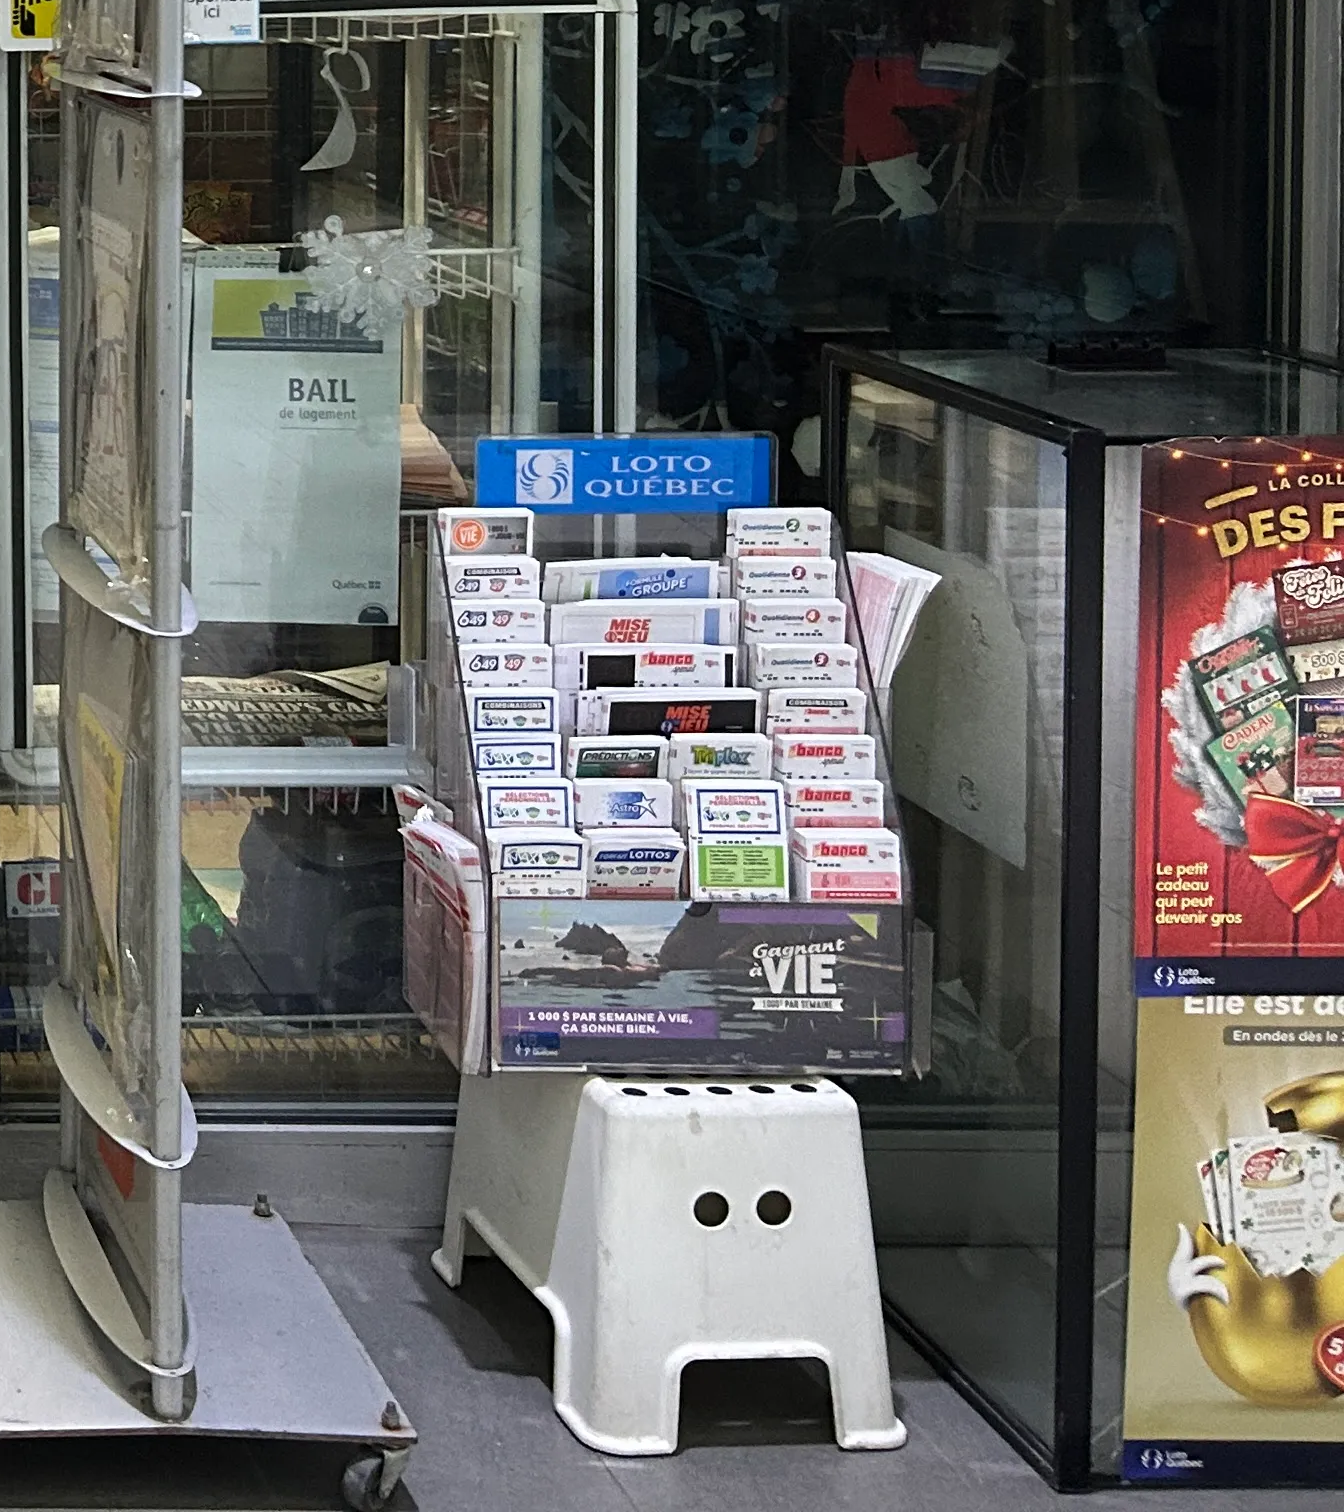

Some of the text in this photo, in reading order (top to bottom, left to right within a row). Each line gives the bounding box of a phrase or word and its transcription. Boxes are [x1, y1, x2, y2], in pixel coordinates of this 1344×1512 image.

[203, 4, 219, 18] ici
[288, 378, 355, 402] BAIL
[279, 408, 356, 422] de logement
[611, 456, 711, 473] LOTO
[584, 476, 733, 497] QUÉBEC
[1269, 479, 1290, 491] LA
[788, 519, 798, 531] 2
[1212, 505, 1310, 558] DES
[332, 579, 367, 590] Québec
[632, 578, 687, 597] GROUPE
[458, 610, 487, 627] 649
[610, 619, 651, 631] MISE
[470, 655, 498, 672] 649
[648, 652, 694, 665] banco
[1312, 651, 1335, 667] 500
[666, 705, 711, 718] MISE
[1222, 713, 1274, 751] CADEAU
[584, 751, 653, 762] PRÉDICTIONS
[691, 744, 751, 767] Triplex
[796, 743, 845, 756] banco
[804, 788, 852, 802] banco
[612, 804, 639, 813] Astro
[630, 850, 671, 860] LOTTOS
[821, 841, 868, 857] banco
[1156, 862, 1208, 878] Le petit
[1156, 880, 1209, 891] cadeau
[1156, 894, 1214, 910] qui peut
[1156, 911, 1242, 927] devenir gros
[753, 938, 845, 960] Gagnant
[749, 953, 837, 995] à VIE
[1178, 968, 1199, 976] Loto
[1178, 975, 1215, 985] Québec
[1184, 995, 1305, 1015] Elle est
[537, 1012, 560, 1022] 000
[563, 1011, 570, 1023] $
[572, 1012, 596, 1022] PAR
[599, 1012, 655, 1022] SEMAINE
[657, 1009, 666, 1022] À
[668, 1012, 693, 1025] VIE,
[561, 1024, 659, 1036] ÇA SONNE BIEN.
[1233, 1029, 1338, 1042] En ondes dès le
